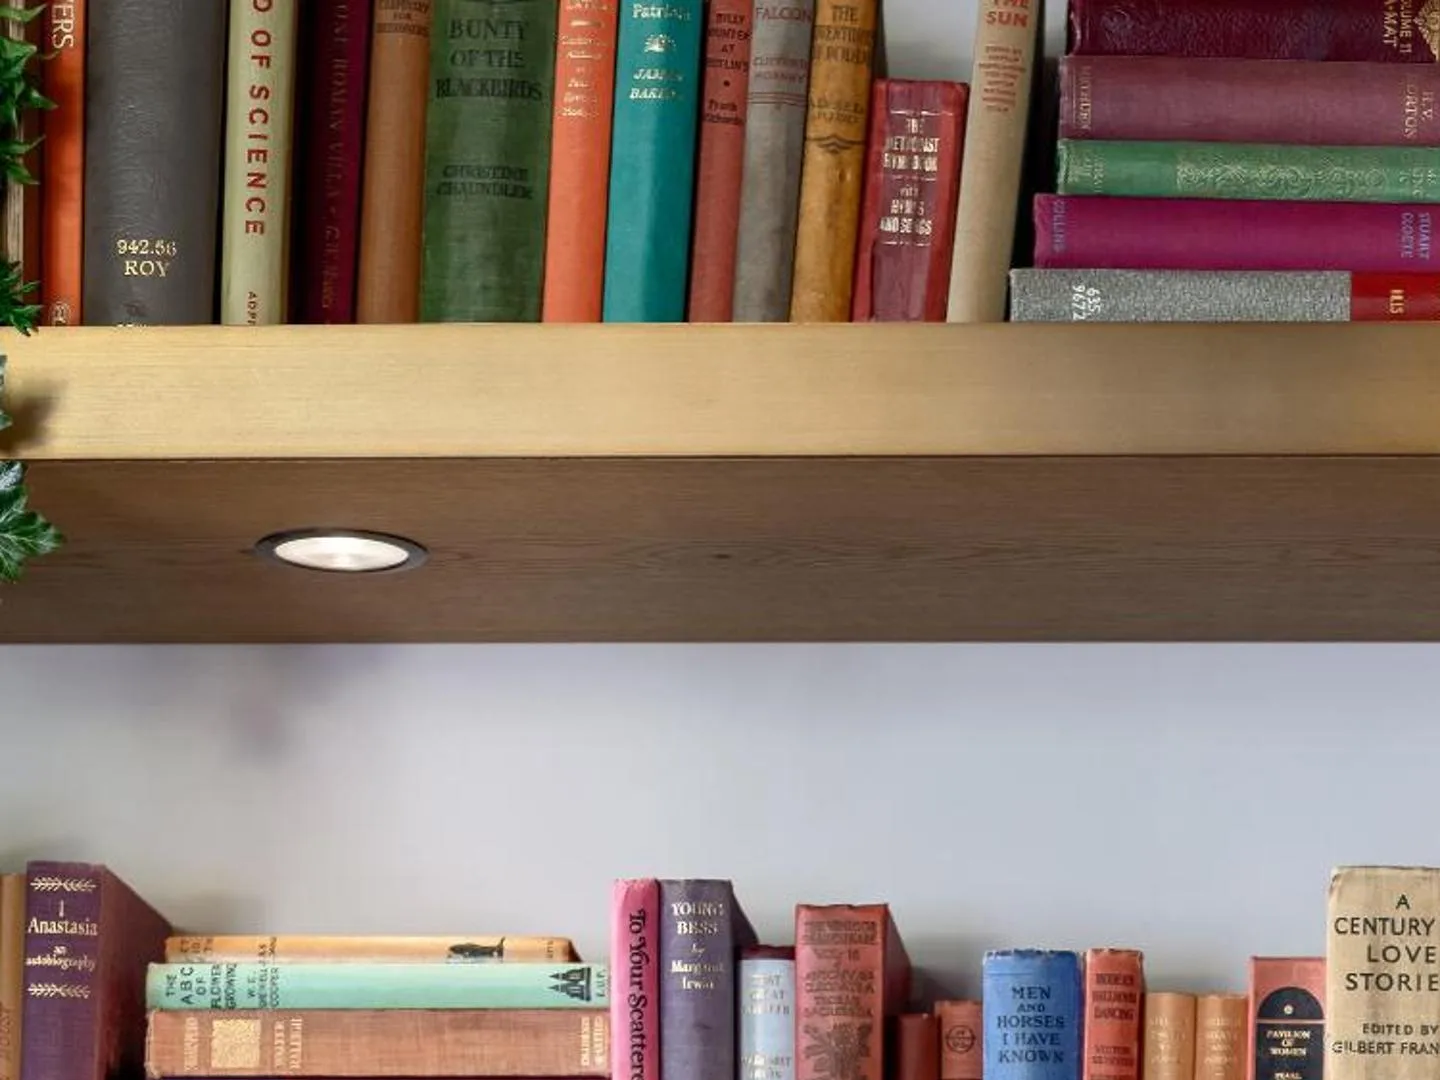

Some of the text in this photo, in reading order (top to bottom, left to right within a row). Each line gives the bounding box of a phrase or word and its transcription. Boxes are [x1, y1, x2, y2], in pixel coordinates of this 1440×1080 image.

[830, 5, 859, 23] THE
[985, 11, 1028, 27] SUN
[51, 0, 74, 49] ERS
[447, 19, 530, 41] BUNTY
[250, 29, 272, 69] OF
[450, 49, 525, 69] OF THE
[245, 85, 270, 236] SCIENCE
[117, 240, 178, 256] 942.56
[124, 261, 170, 277] ROY
[671, 902, 725, 917] YOUNG
[1395, 894, 1411, 910] A
[28, 917, 98, 936] Anastasia
[628, 909, 648, 933] To
[676, 920, 719, 936] BESS
[1334, 916, 1435, 937] CENTURY
[25, 954, 95, 972] autobiography
[628, 935, 651, 993] Your
[1366, 946, 1437, 964] LOVE
[166, 974, 177, 997] THE
[196, 976, 206, 996] OF
[1011, 986, 1051, 1000] MEN
[1017, 1003, 1046, 1013] AND
[997, 1015, 1065, 1029] HORSES
[1362, 1022, 1439, 1036] EDITED BY
[1013, 1033, 1061, 1046] HAVE
[1332, 1041, 1395, 1055] GILBERT
[998, 1050, 1065, 1064] KNOWN
